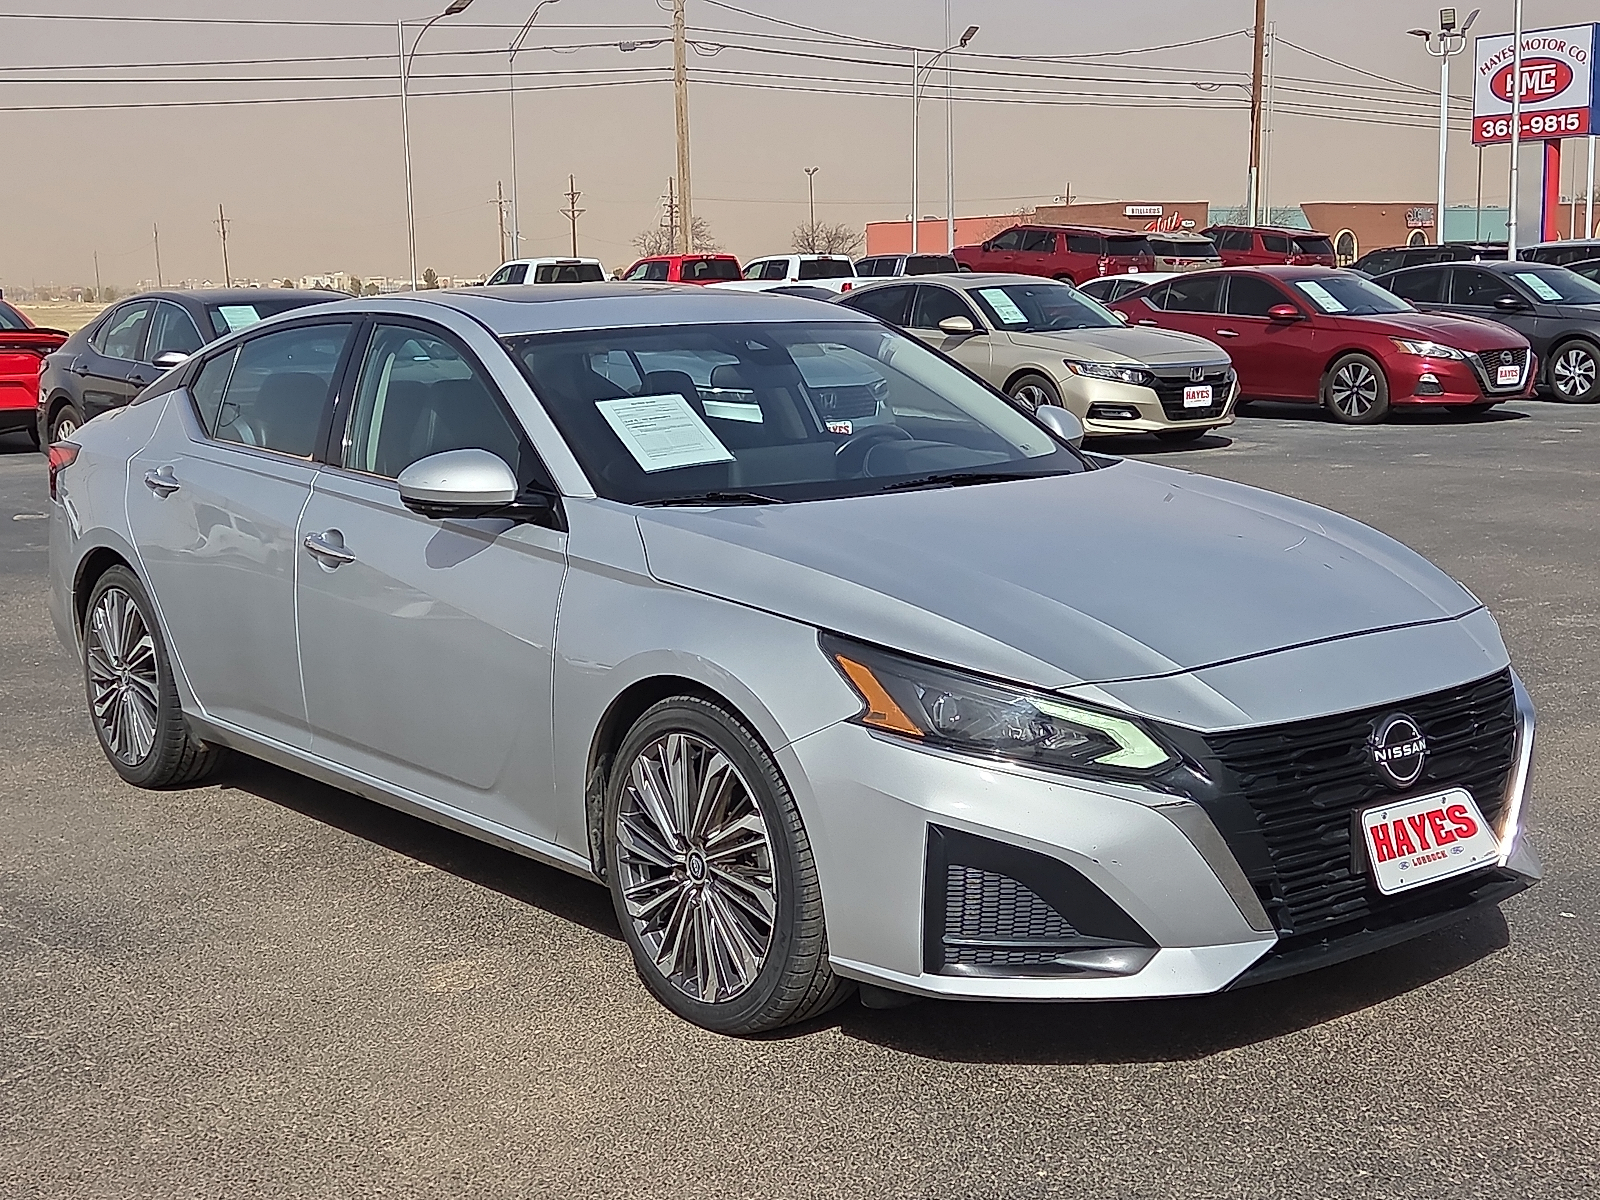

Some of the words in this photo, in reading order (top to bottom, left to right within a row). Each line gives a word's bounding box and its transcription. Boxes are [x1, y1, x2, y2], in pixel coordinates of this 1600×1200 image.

[1480, 45, 1514, 76] HAYES
[1520, 38, 1566, 53] MOTOR
[1568, 45, 1587, 65] CO.
[1185, 389, 1210, 400] HAYES
[1374, 738, 1427, 762] NISSAN
[1369, 804, 1479, 864] HAYES
